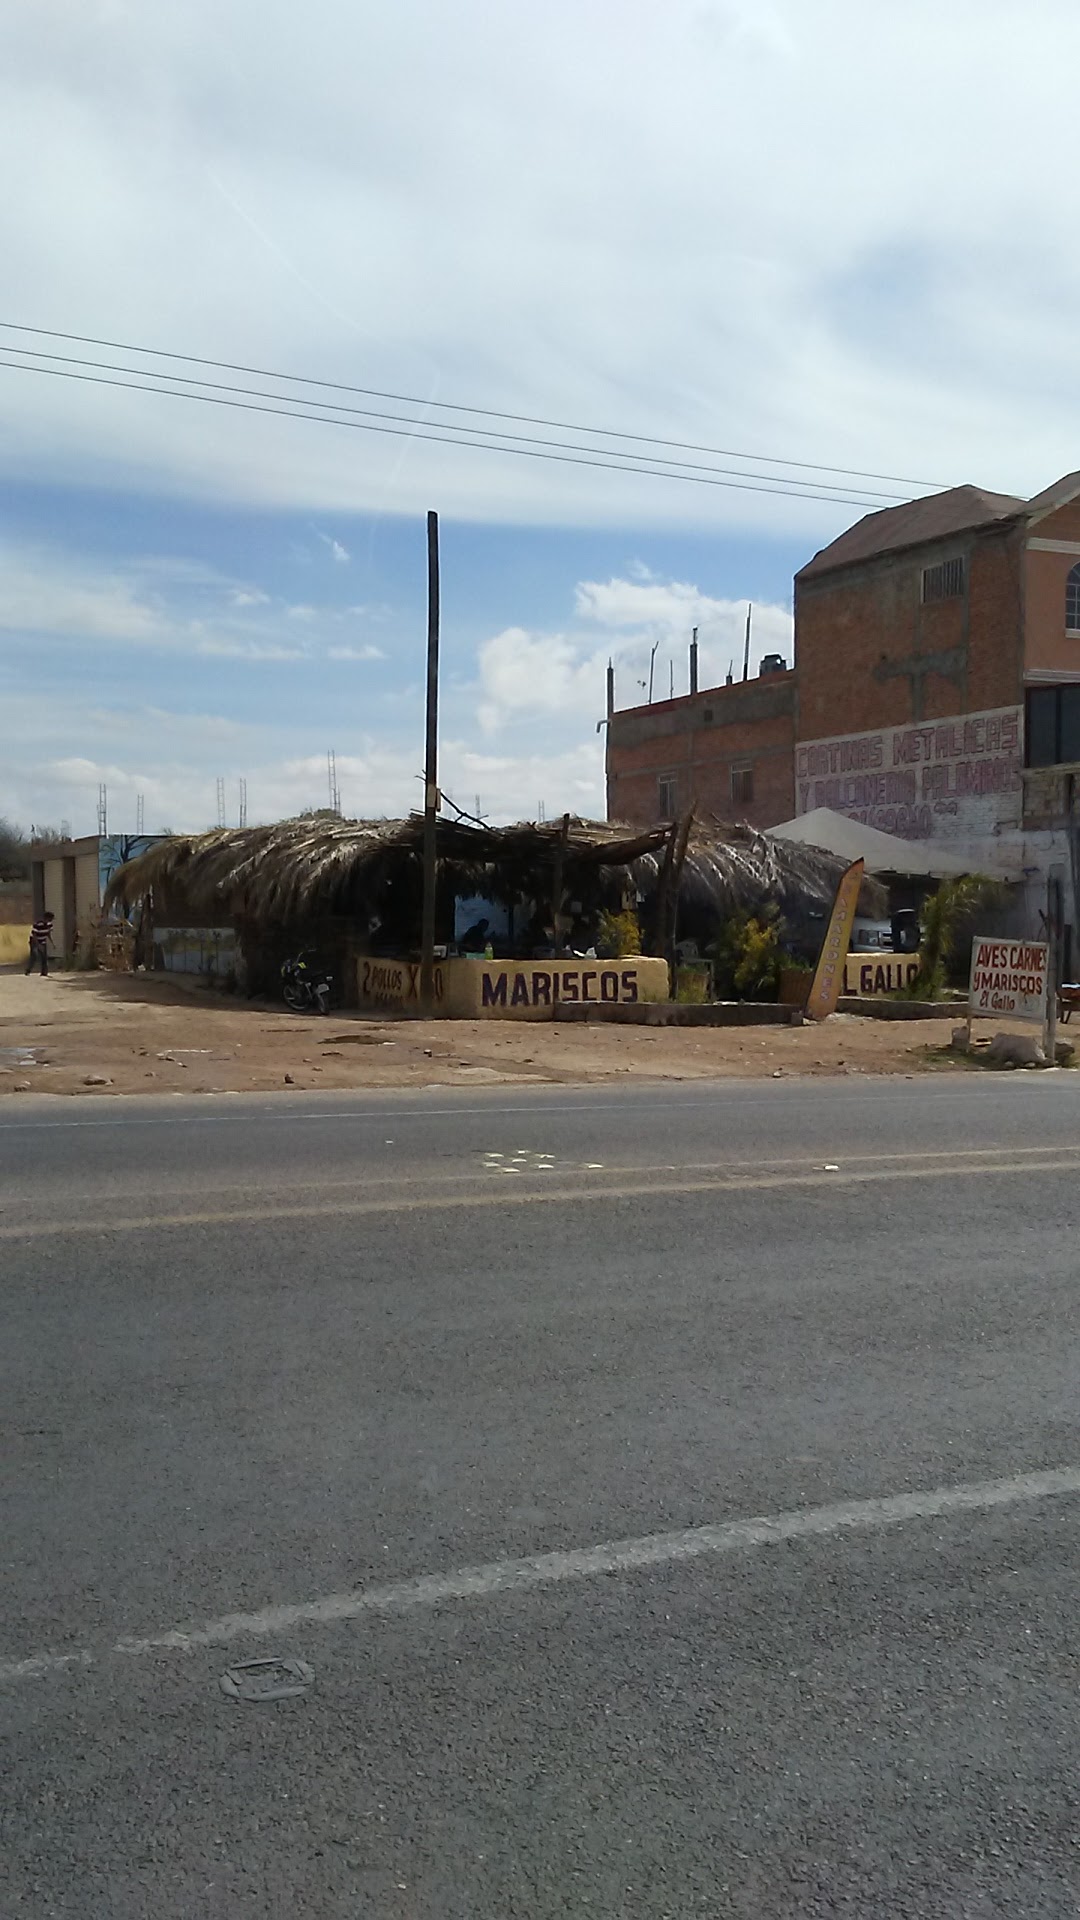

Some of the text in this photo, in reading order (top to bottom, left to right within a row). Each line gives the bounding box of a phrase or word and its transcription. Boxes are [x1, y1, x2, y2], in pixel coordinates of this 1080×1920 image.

[797, 713, 1018, 777] CORTINAS METALICAS
[976, 945, 1047, 971] AVES CARNES
[363, 961, 372, 993] 2
[372, 966, 402, 991] POLLOS
[482, 971, 638, 1007] MARISCOS
[843, 964, 857, 996] L
[991, 992, 1016, 1011] Gallo
